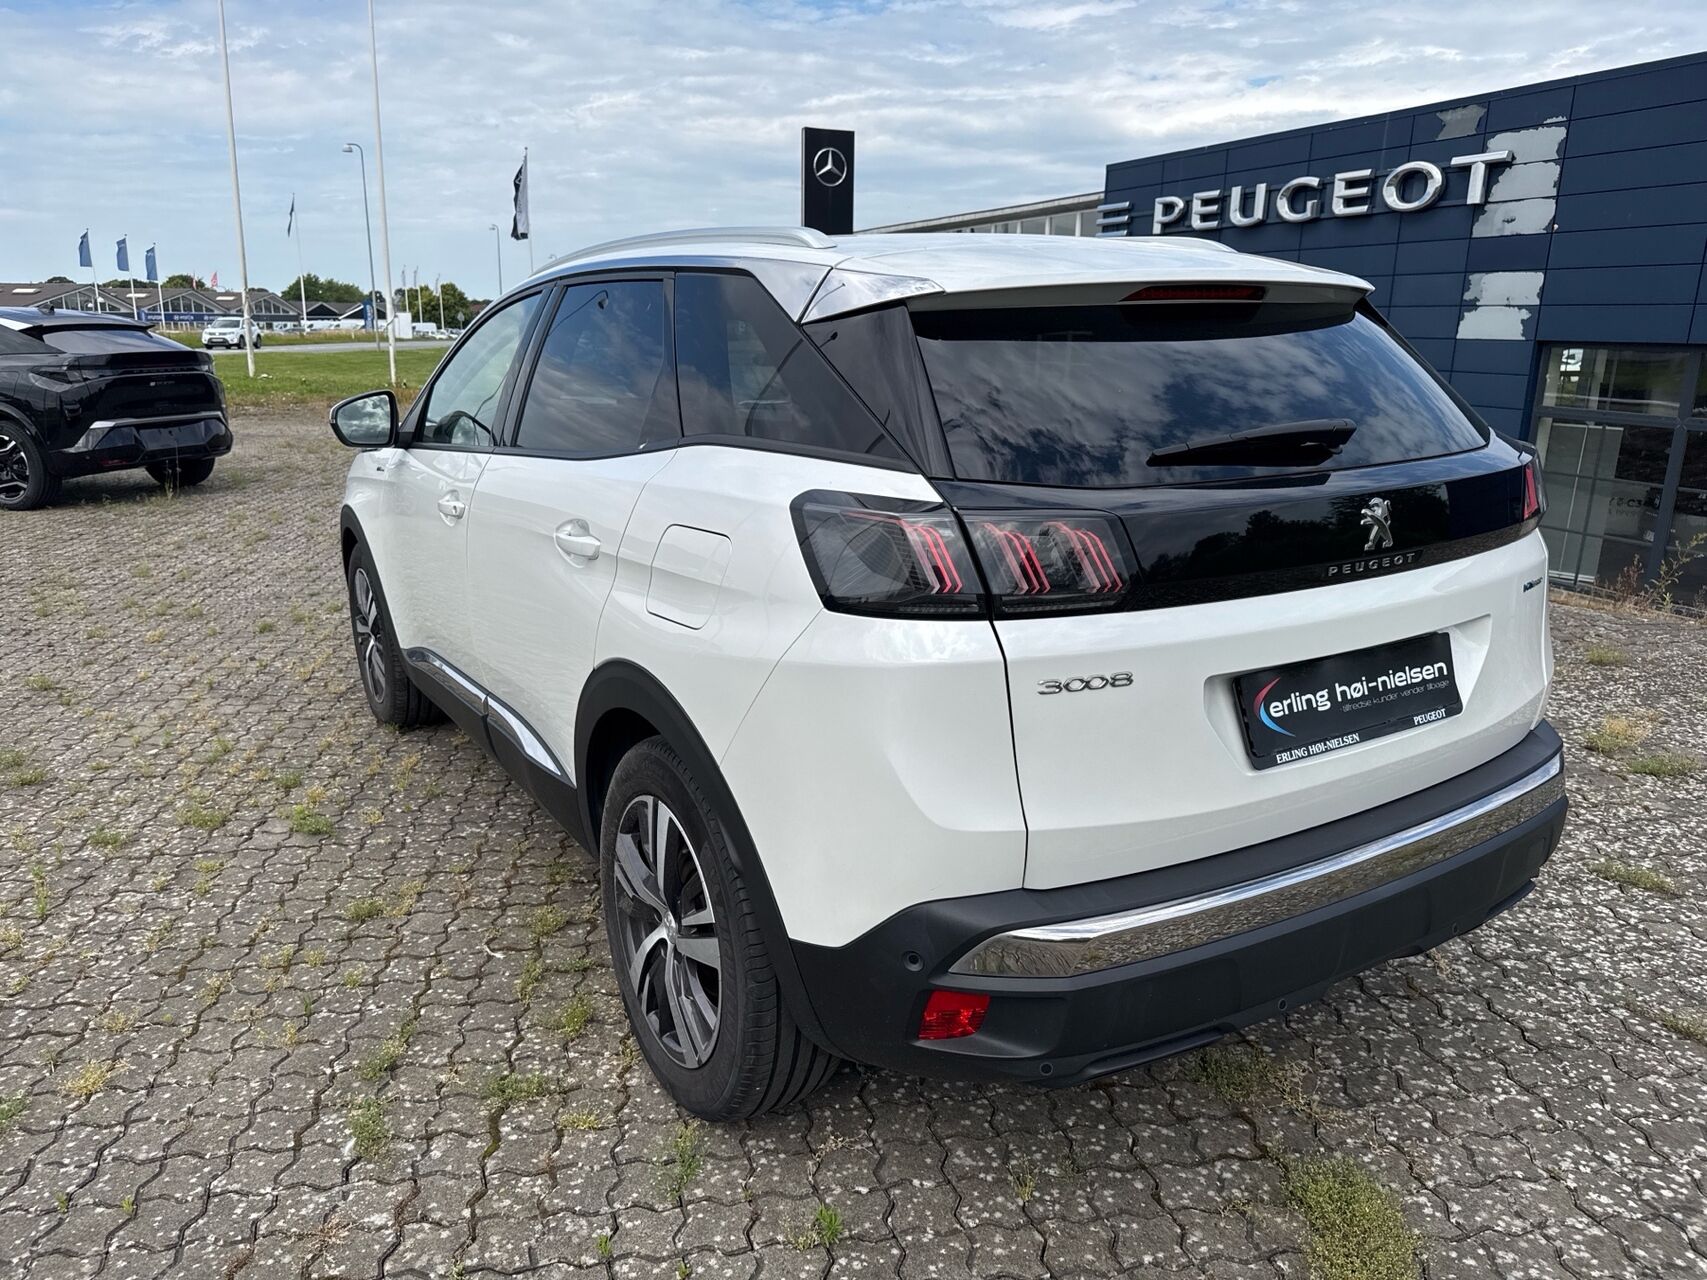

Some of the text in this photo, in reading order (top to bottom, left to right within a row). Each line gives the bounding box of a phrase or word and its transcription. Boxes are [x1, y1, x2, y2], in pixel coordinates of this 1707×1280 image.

[1152, 150, 1513, 235] PEUGEOT
[1327, 553, 1415, 577] PEUGEOT
[1037, 671, 1134, 695] 3008
[1269, 662, 1448, 718] erling høi-nielsen
[1400, 686, 1425, 697] vender
[1413, 708, 1447, 726] PEUGEOT
[1276, 732, 1360, 764] ERLING HØI-NIELSEN
